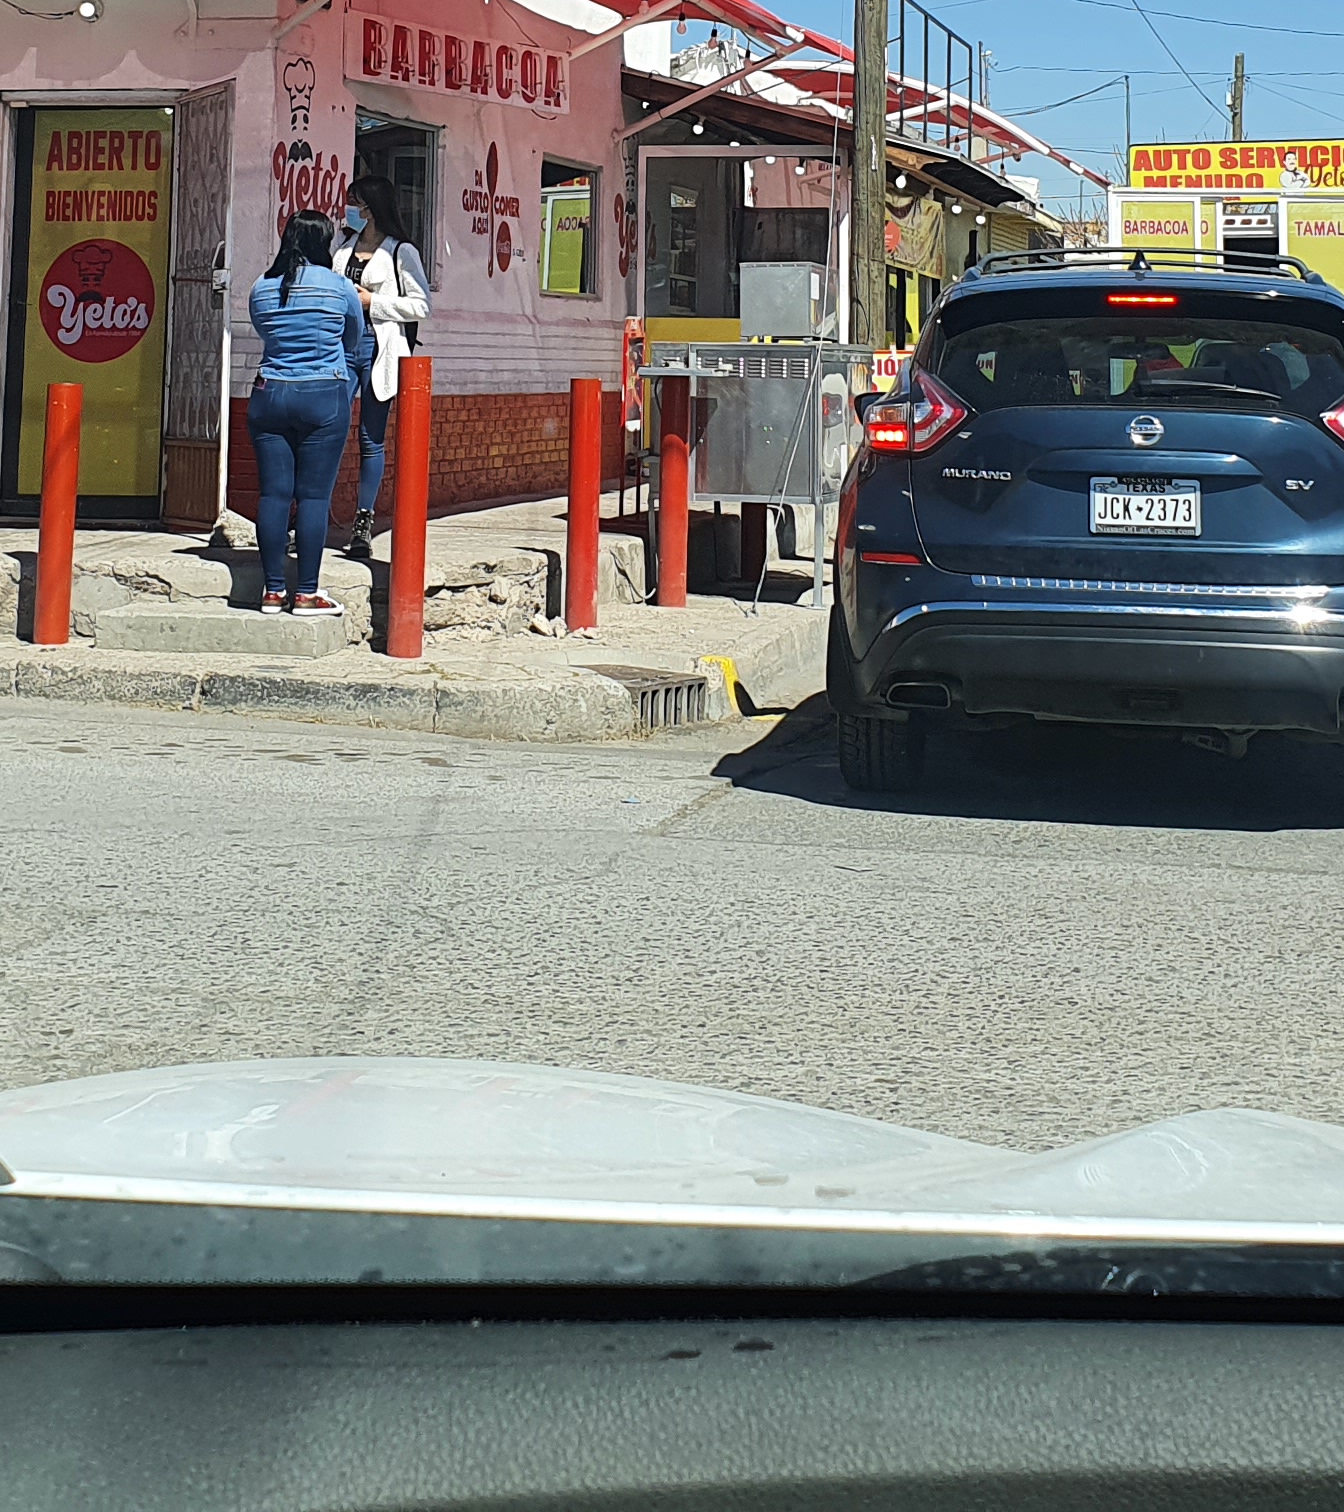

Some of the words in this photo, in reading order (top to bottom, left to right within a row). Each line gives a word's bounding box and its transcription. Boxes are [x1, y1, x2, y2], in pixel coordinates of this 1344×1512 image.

[362, 17, 566, 109] BARBACOA
[46, 130, 162, 172] ABIERTO
[1132, 148, 1212, 171] AUTO
[1143, 172, 1265, 188] MENUDO
[45, 190, 158, 222] BIENVENIDOS
[462, 189, 490, 213] GUSTO
[494, 196, 520, 218] COMER
[1123, 220, 1190, 235] BARBACOA
[47, 284, 149, 345] Yeto's
[941, 467, 1013, 481] MURANO
[1285, 478, 1315, 491] SV
[1125, 484, 1167, 493] TEXAS
